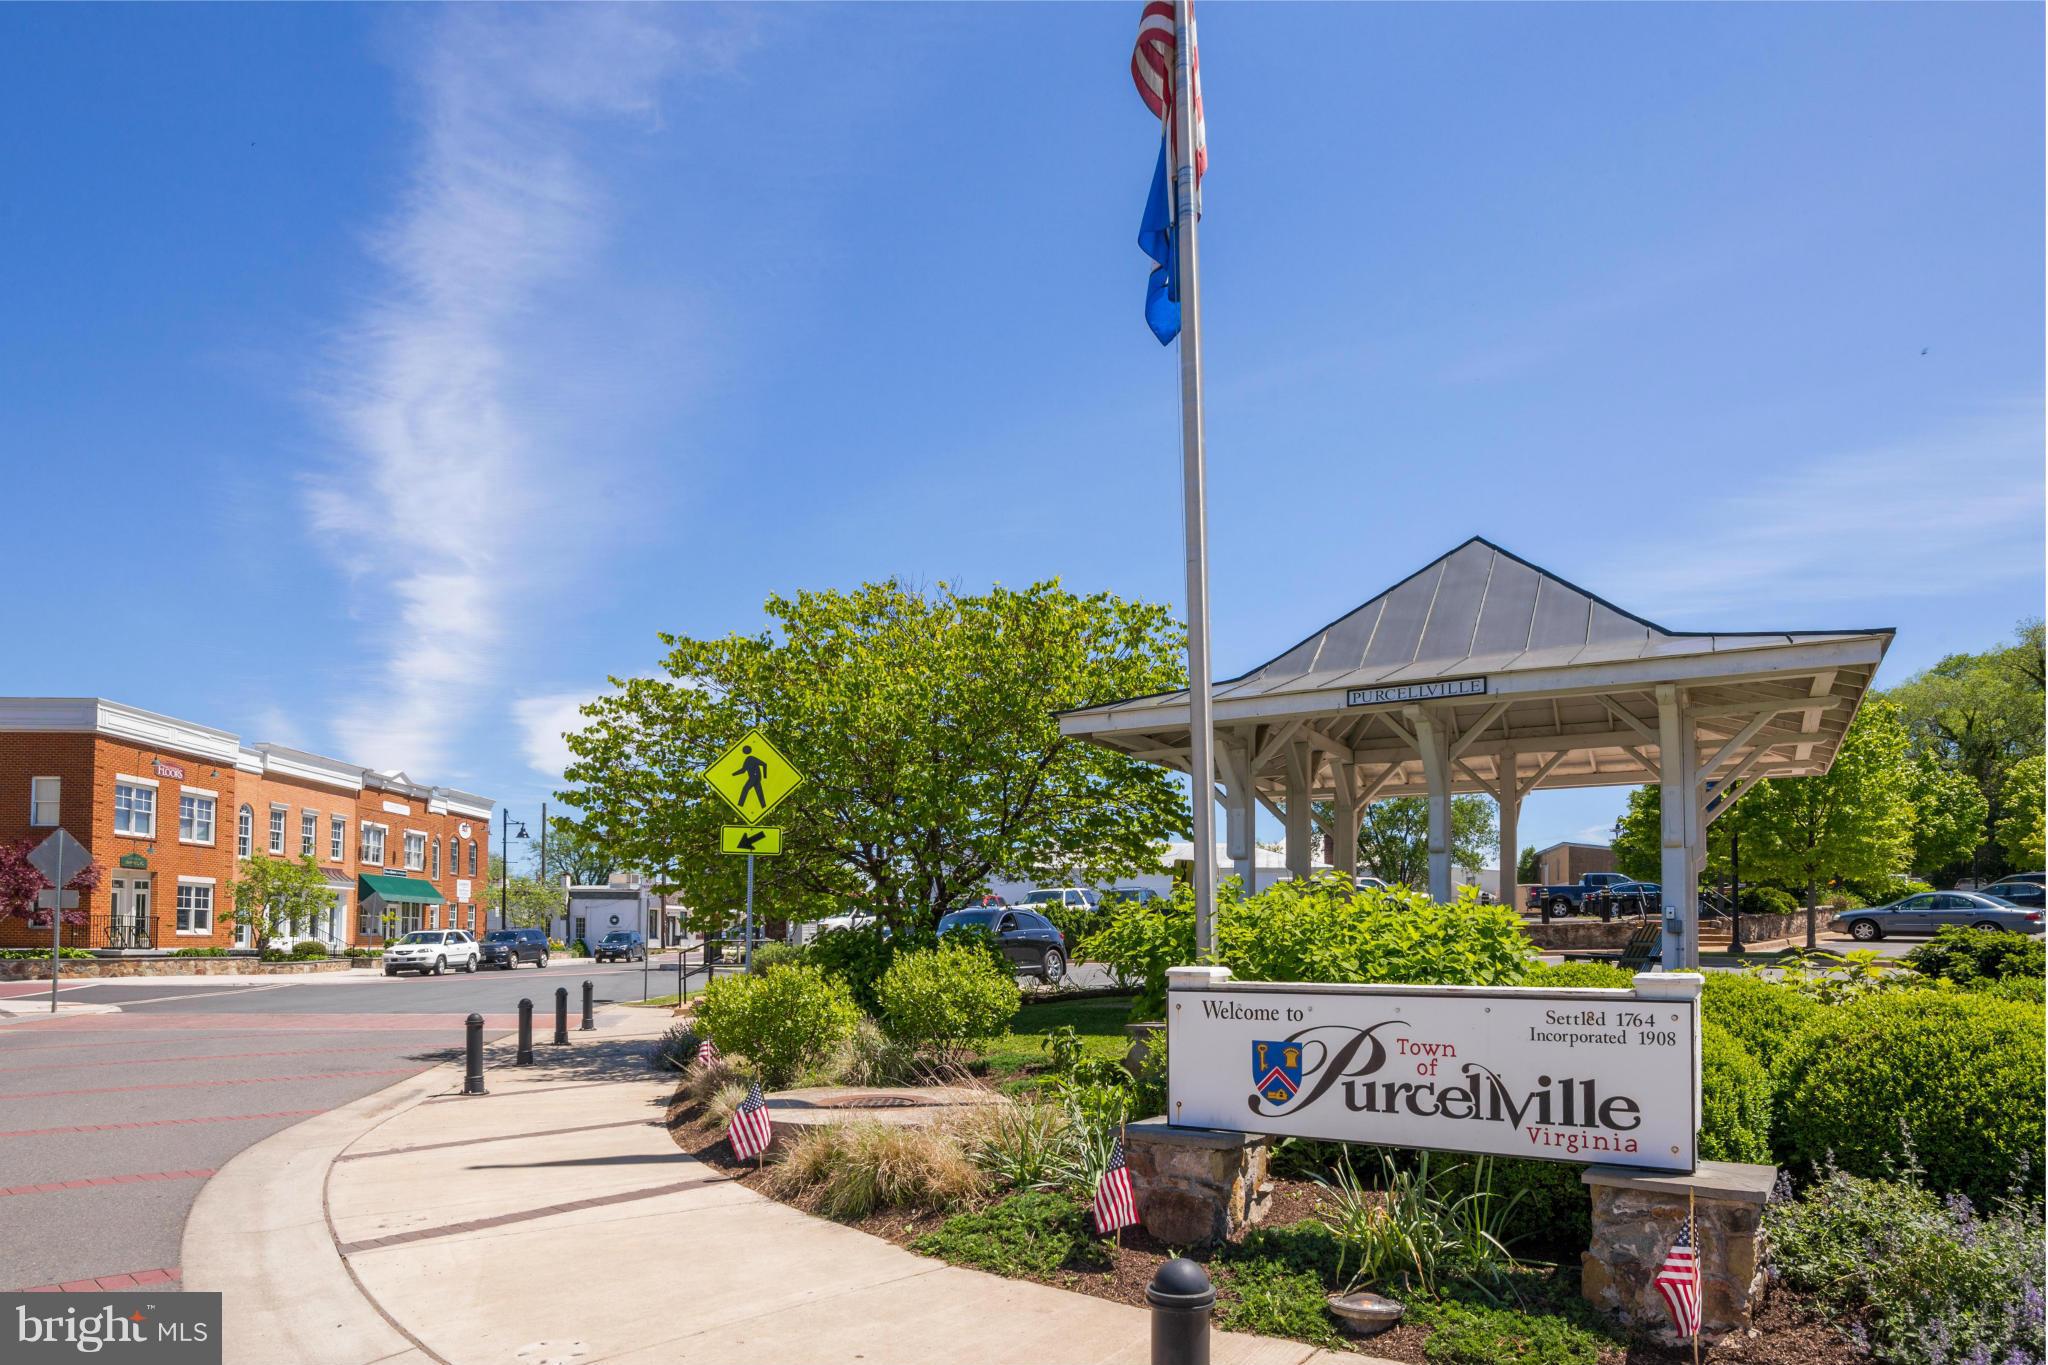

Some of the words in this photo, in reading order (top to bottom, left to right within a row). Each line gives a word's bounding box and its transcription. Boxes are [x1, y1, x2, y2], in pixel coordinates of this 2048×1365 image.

[1352, 680, 1481, 704] PURCELLVILLE
[1201, 1000, 1280, 1021] Welcome
[1287, 1007, 1304, 1022] to
[1545, 1009, 1606, 1026] Settled
[1616, 1012, 1656, 1028] 1764
[1529, 1026, 1627, 1047] Incorporated
[1638, 1031, 1677, 1046] 1908
[1396, 1038, 1457, 1058] Town
[1416, 1058, 1439, 1077] of
[1526, 1126, 1639, 1153] Virginia
